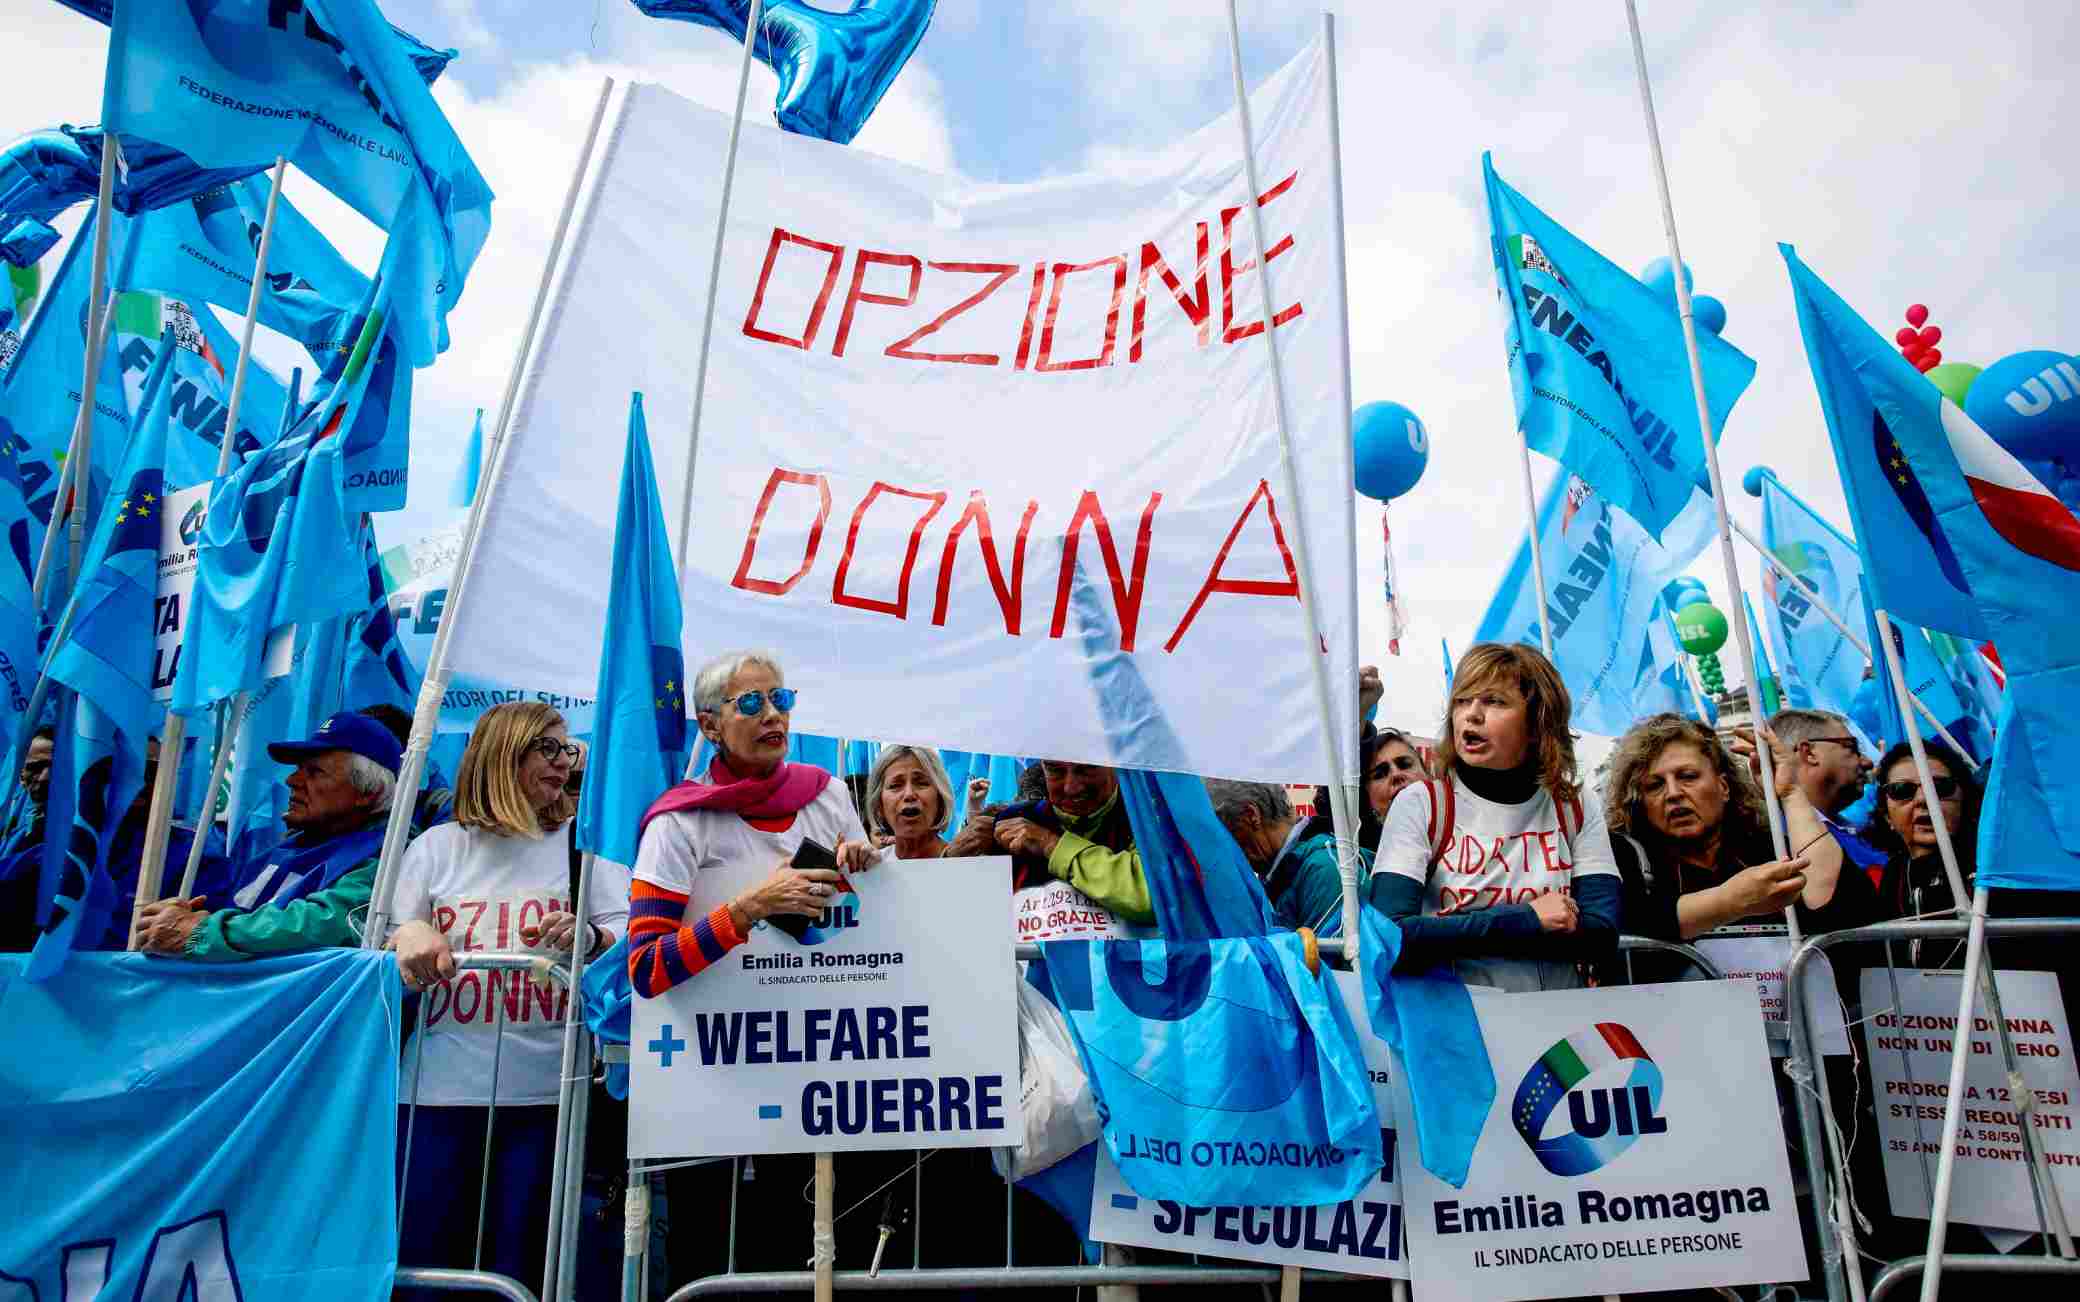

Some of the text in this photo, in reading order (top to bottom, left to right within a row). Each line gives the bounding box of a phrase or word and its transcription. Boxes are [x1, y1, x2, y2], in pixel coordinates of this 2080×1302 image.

[178, 75, 294, 120] FEDERAZIONE
[742, 171, 1304, 373] OPZIONE
[730, 468, 1327, 654] DONNA
[1017, 917, 1041, 933] NO
[1048, 910, 1107, 929] GRAZIE
[742, 951, 904, 970] Emilia Romagna
[758, 972, 889, 985] IL SINDACATO DELLE PERSONE
[695, 1005, 931, 1066] WELFARE
[1875, 1014, 2055, 1034] OPZION DNNA
[1878, 1037, 1918, 1051] NON
[1973, 1041, 1993, 1055] DI
[2010, 1043, 2060, 1058] ENO
[800, 1075, 1005, 1136] GUERRE
[1886, 1081, 2069, 1105] PROROA 12 ESI
[1567, 1086, 1668, 1139] UIL
[1966, 1109, 2072, 1130] REQUSITI
[1889, 1139, 1907, 1152] 35
[1957, 1145, 1972, 1157] DI
[1434, 1186, 1770, 1234] Emilia Romagna
[1475, 1232, 1744, 1268] IL SINDACATO DELLE PERSONE
